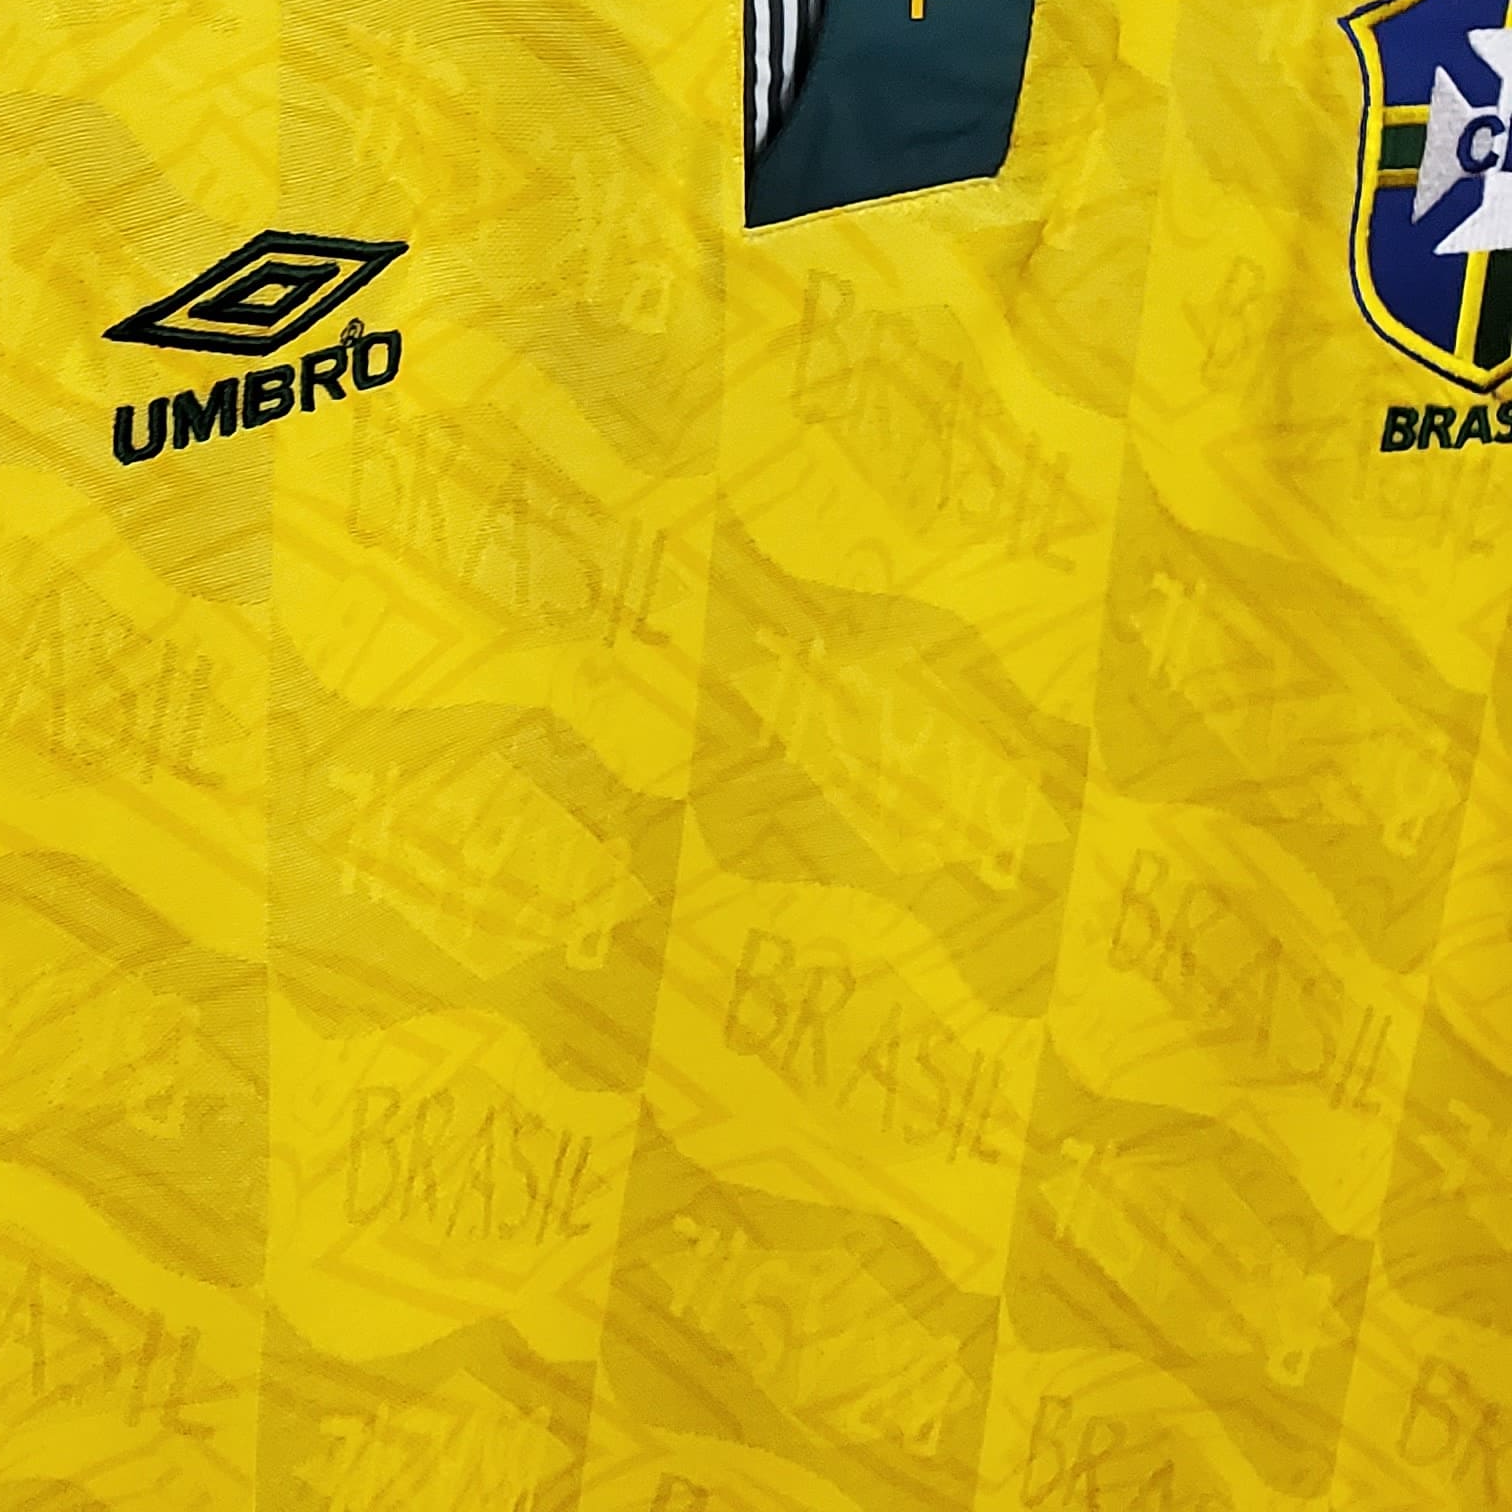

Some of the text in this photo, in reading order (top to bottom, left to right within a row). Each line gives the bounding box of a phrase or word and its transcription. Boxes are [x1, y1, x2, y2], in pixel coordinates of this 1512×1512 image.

[1456, 113, 1512, 175] C
[112, 328, 403, 466] UMBRO
[723, 926, 1003, 1166] BRASIL
[342, 1086, 594, 1248] BRASIL
